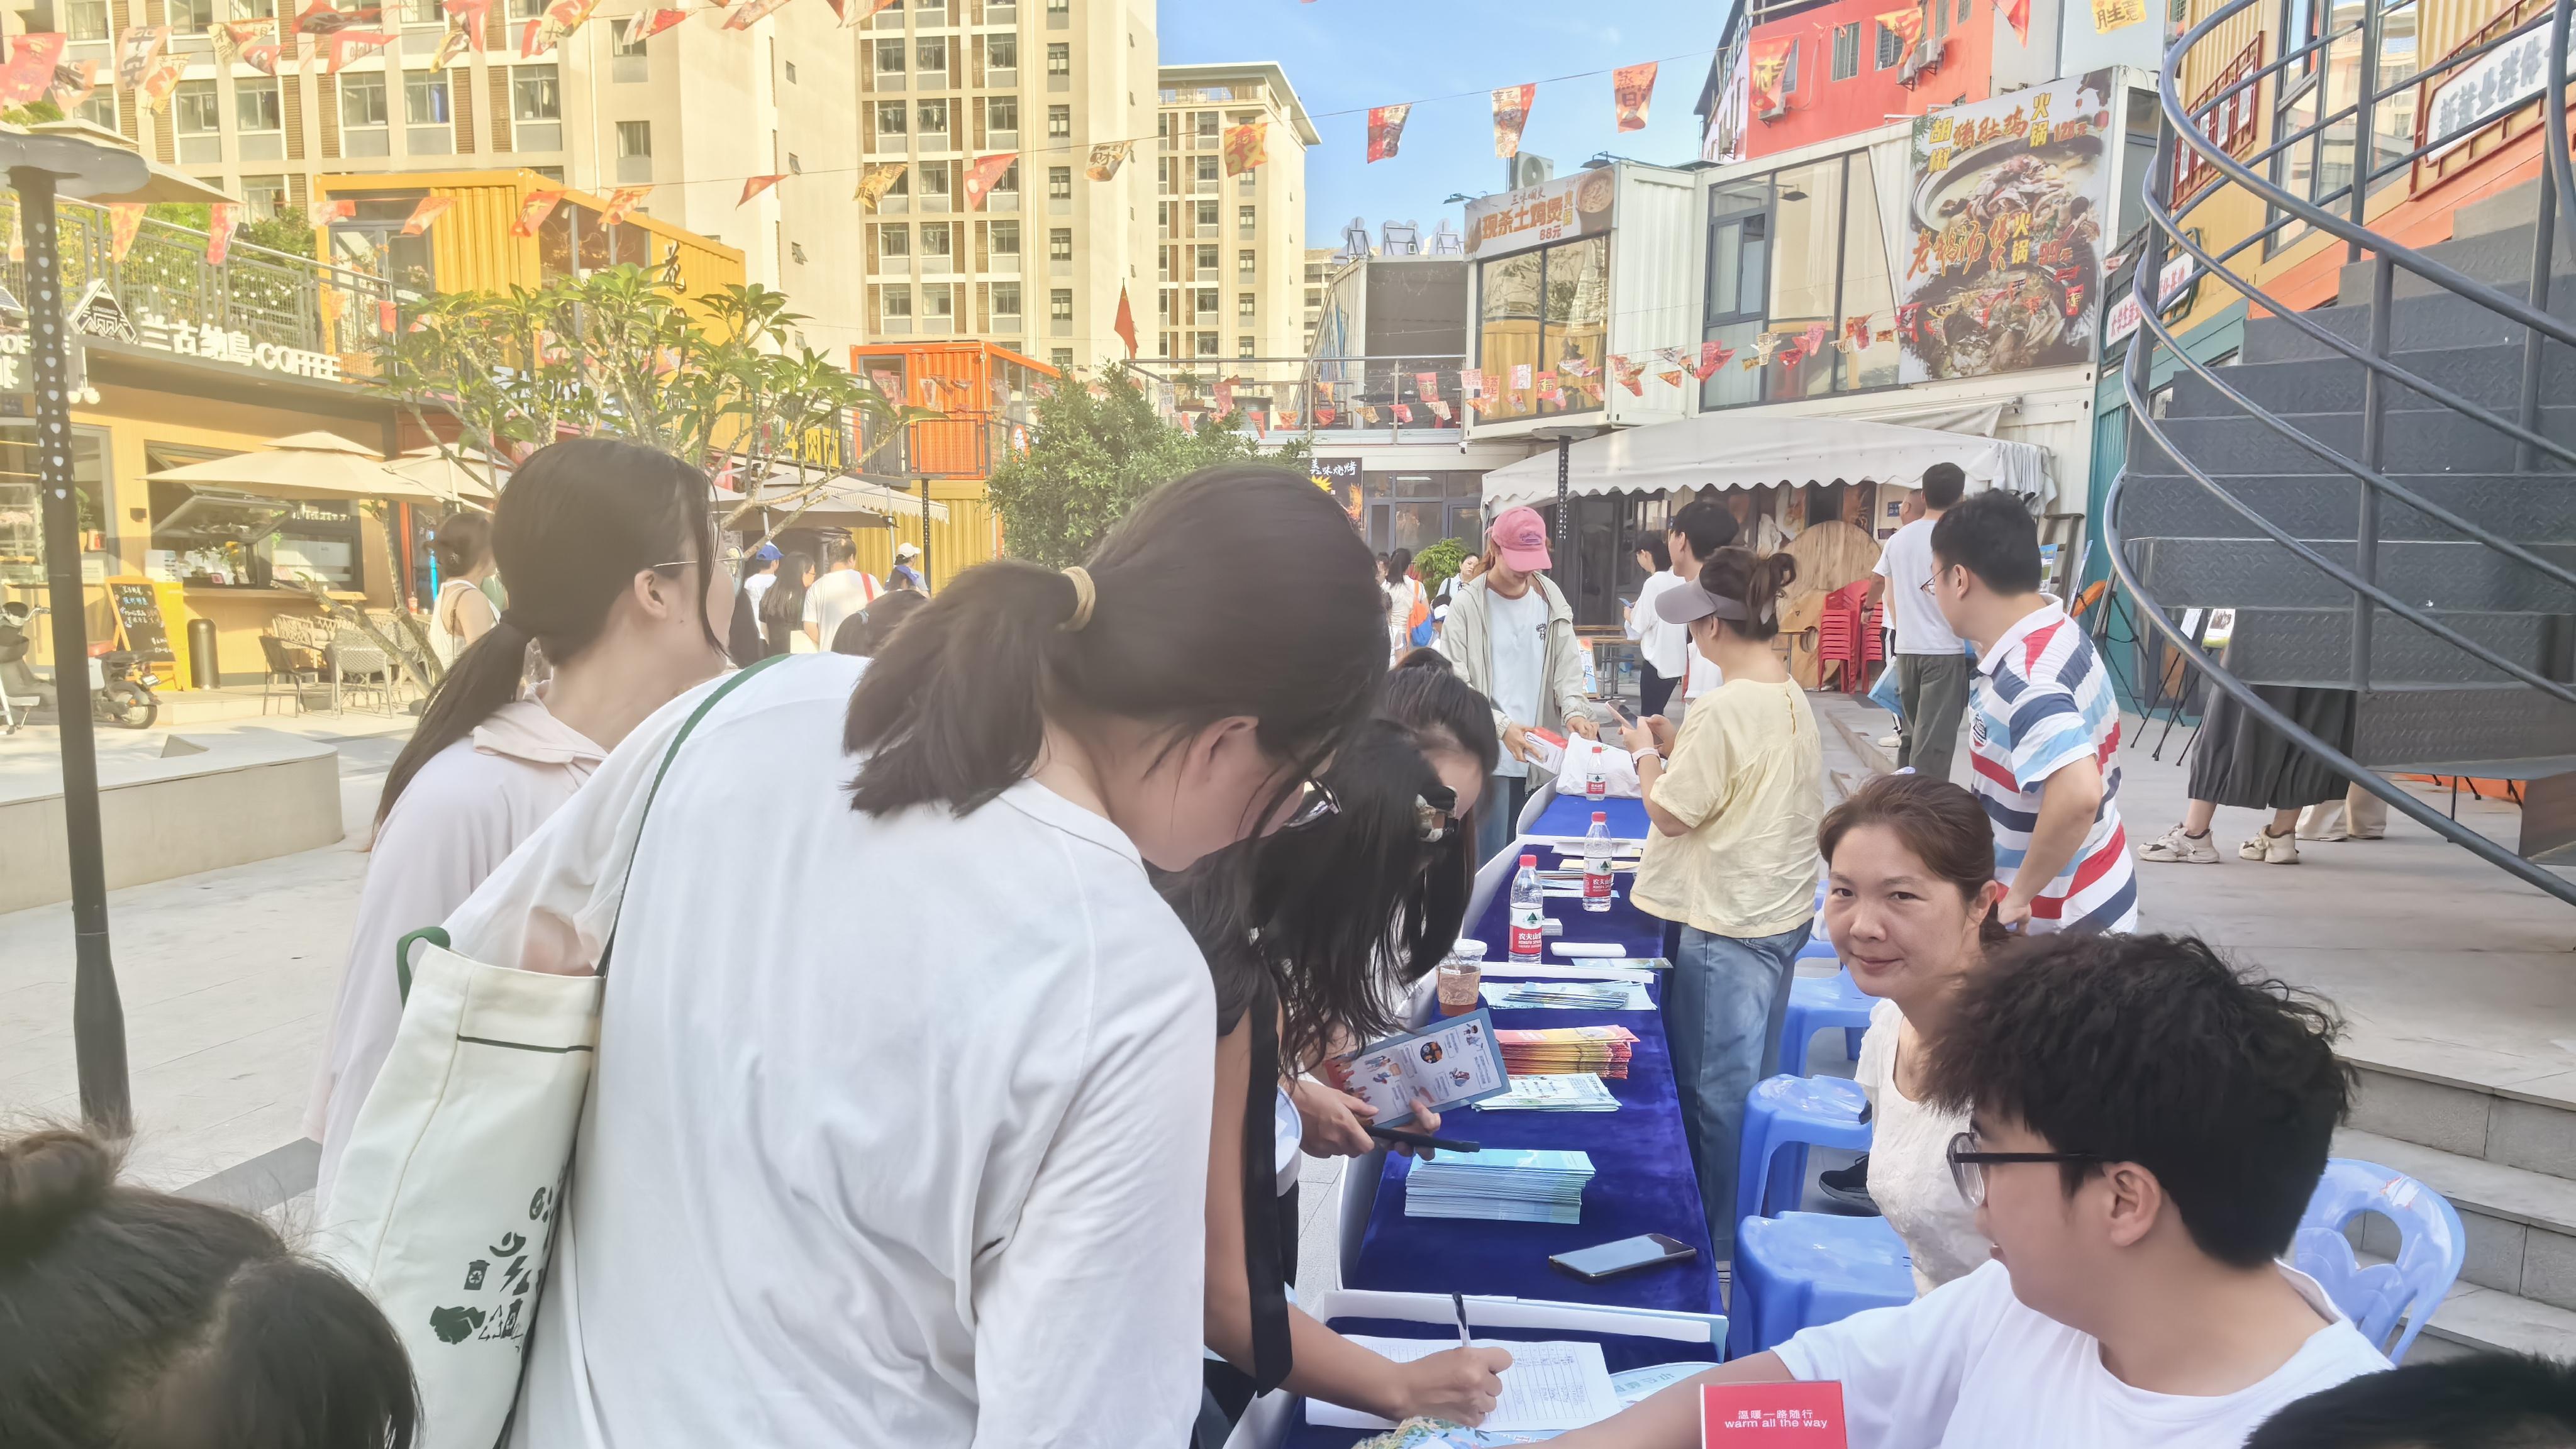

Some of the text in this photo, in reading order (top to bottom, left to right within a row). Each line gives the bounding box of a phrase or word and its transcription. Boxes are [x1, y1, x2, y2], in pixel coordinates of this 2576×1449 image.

[2029, 92, 2052, 148] 火锅
[1927, 116, 1954, 173] 胡椒
[1481, 196, 1563, 240] 现杀土鸡煲
[1539, 225, 1562, 241] 88元
[2011, 212, 2031, 265] 火锅
[255, 342, 341, 382] COFFEE
[1309, 458, 1357, 476] 美味烧烤
[1762, 1419, 1775, 1427] all
[1780, 1419, 1799, 1427] the
[1803, 1419, 1828, 1429] way
